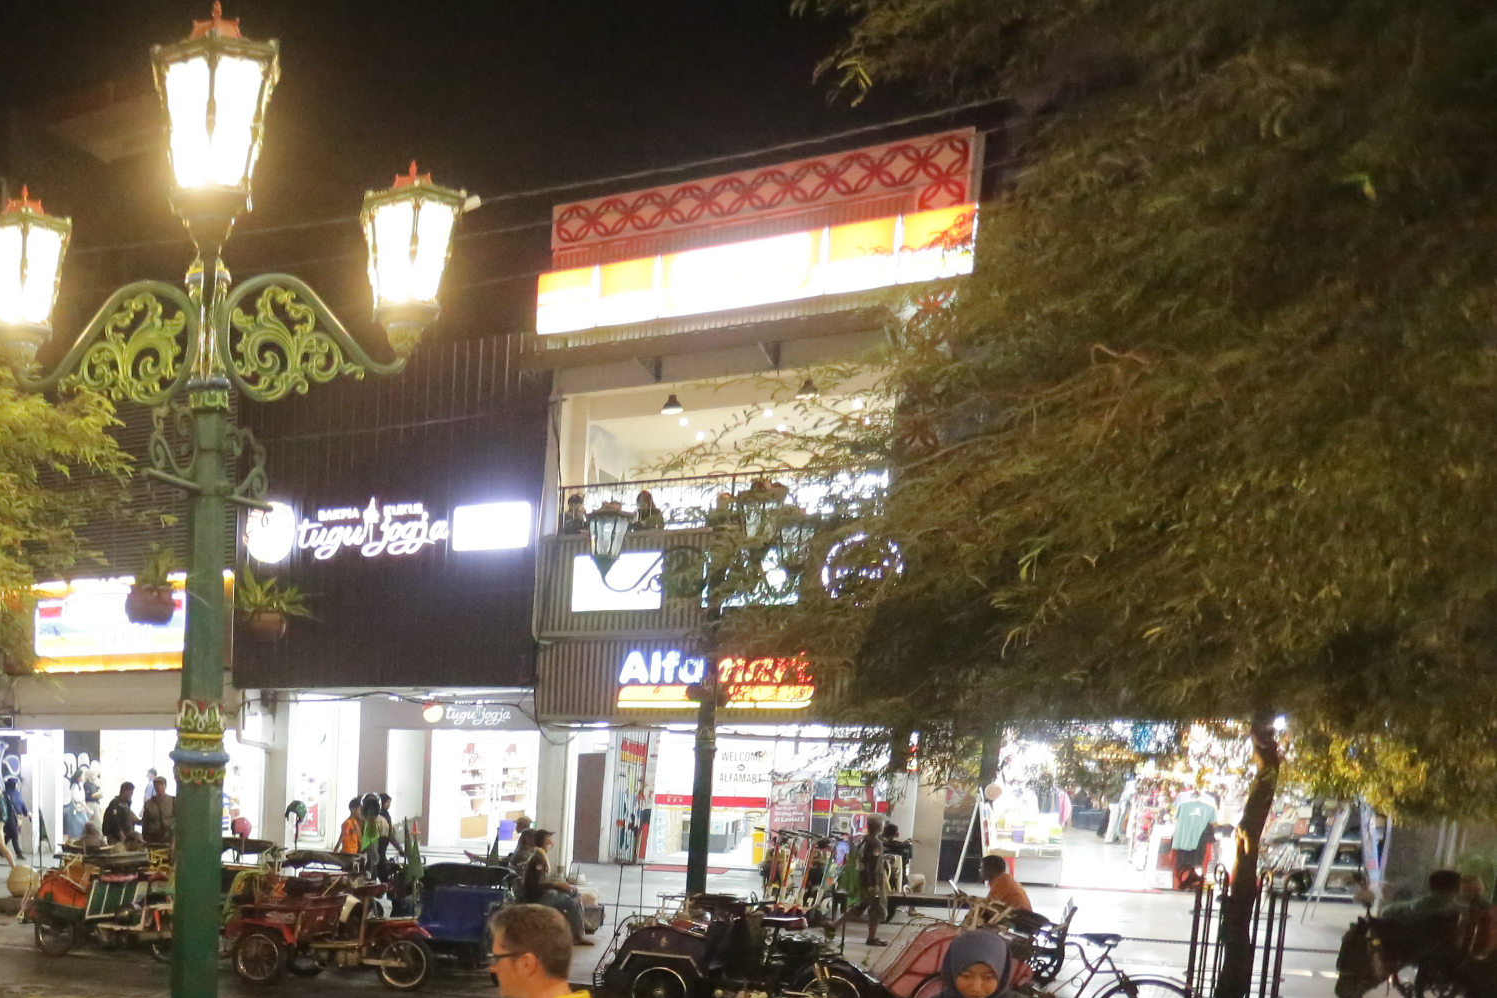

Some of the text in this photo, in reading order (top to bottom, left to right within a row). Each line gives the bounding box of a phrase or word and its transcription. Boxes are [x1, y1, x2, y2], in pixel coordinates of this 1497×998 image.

[297, 511, 450, 560] tugu jogja
[445, 706, 512, 726] tugu jogja
